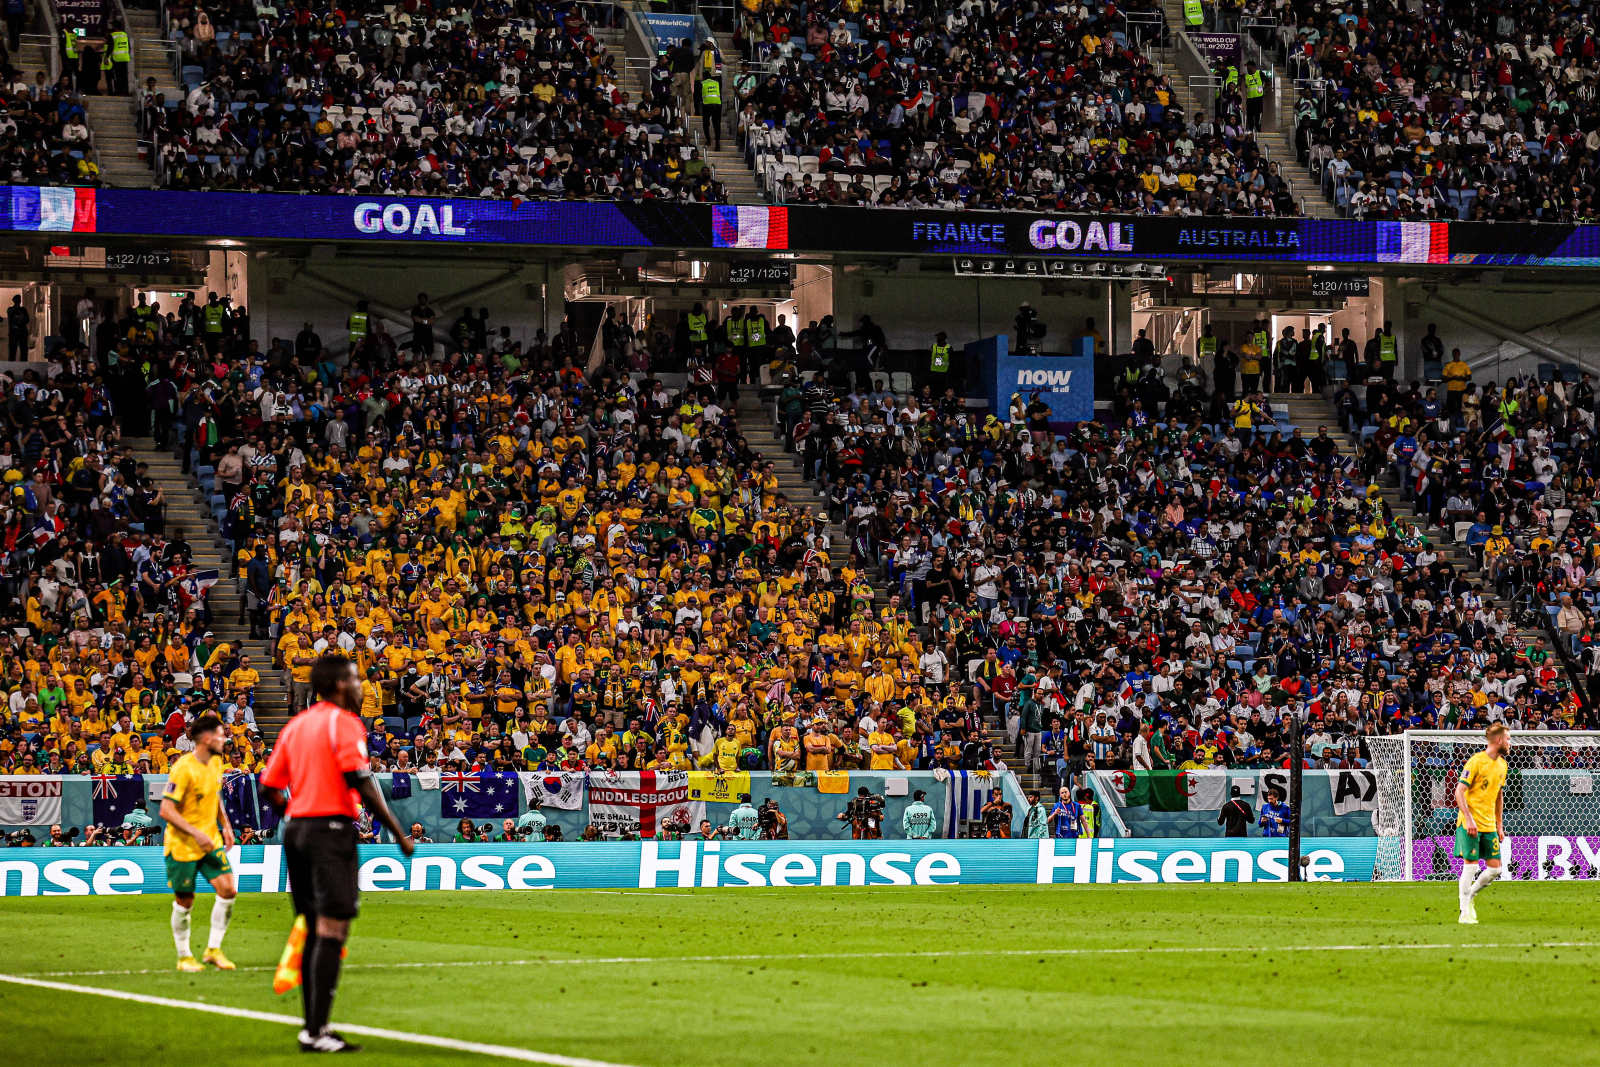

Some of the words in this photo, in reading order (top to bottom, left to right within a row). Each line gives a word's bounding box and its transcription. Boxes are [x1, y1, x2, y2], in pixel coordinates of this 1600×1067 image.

[353, 202, 466, 235] GOAL
[912, 221, 1006, 243] FRANCE
[1029, 219, 1134, 251] GOAL
[1178, 229, 1300, 247] AUSTRALIA
[1017, 369, 1072, 386] now
[668, 772, 688, 783] RED
[0, 782, 61, 797] GTON
[592, 812, 605, 820] WE
[607, 813, 634, 821] SHALL
[638, 840, 961, 888] Hisense
[1037, 838, 1345, 884] Hisense
